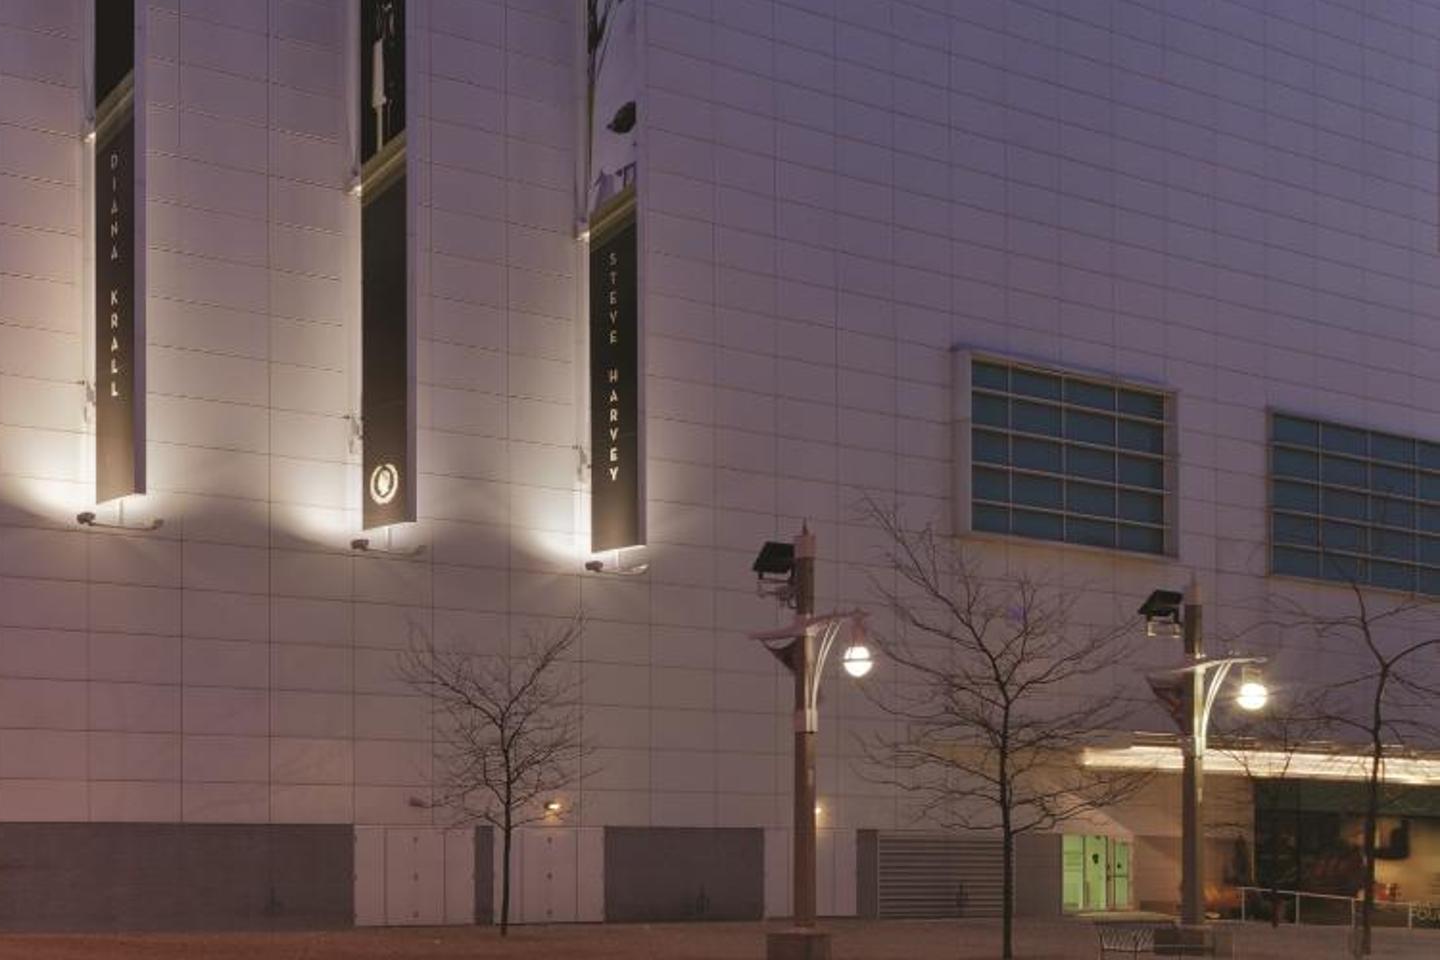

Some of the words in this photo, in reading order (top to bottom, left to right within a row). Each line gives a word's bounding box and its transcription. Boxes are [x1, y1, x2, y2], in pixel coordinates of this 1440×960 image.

[109, 152, 120, 261] DIANA
[109, 290, 120, 398] KRALL
[608, 253, 619, 344] STEVE
[608, 369, 620, 482] HARVEY
